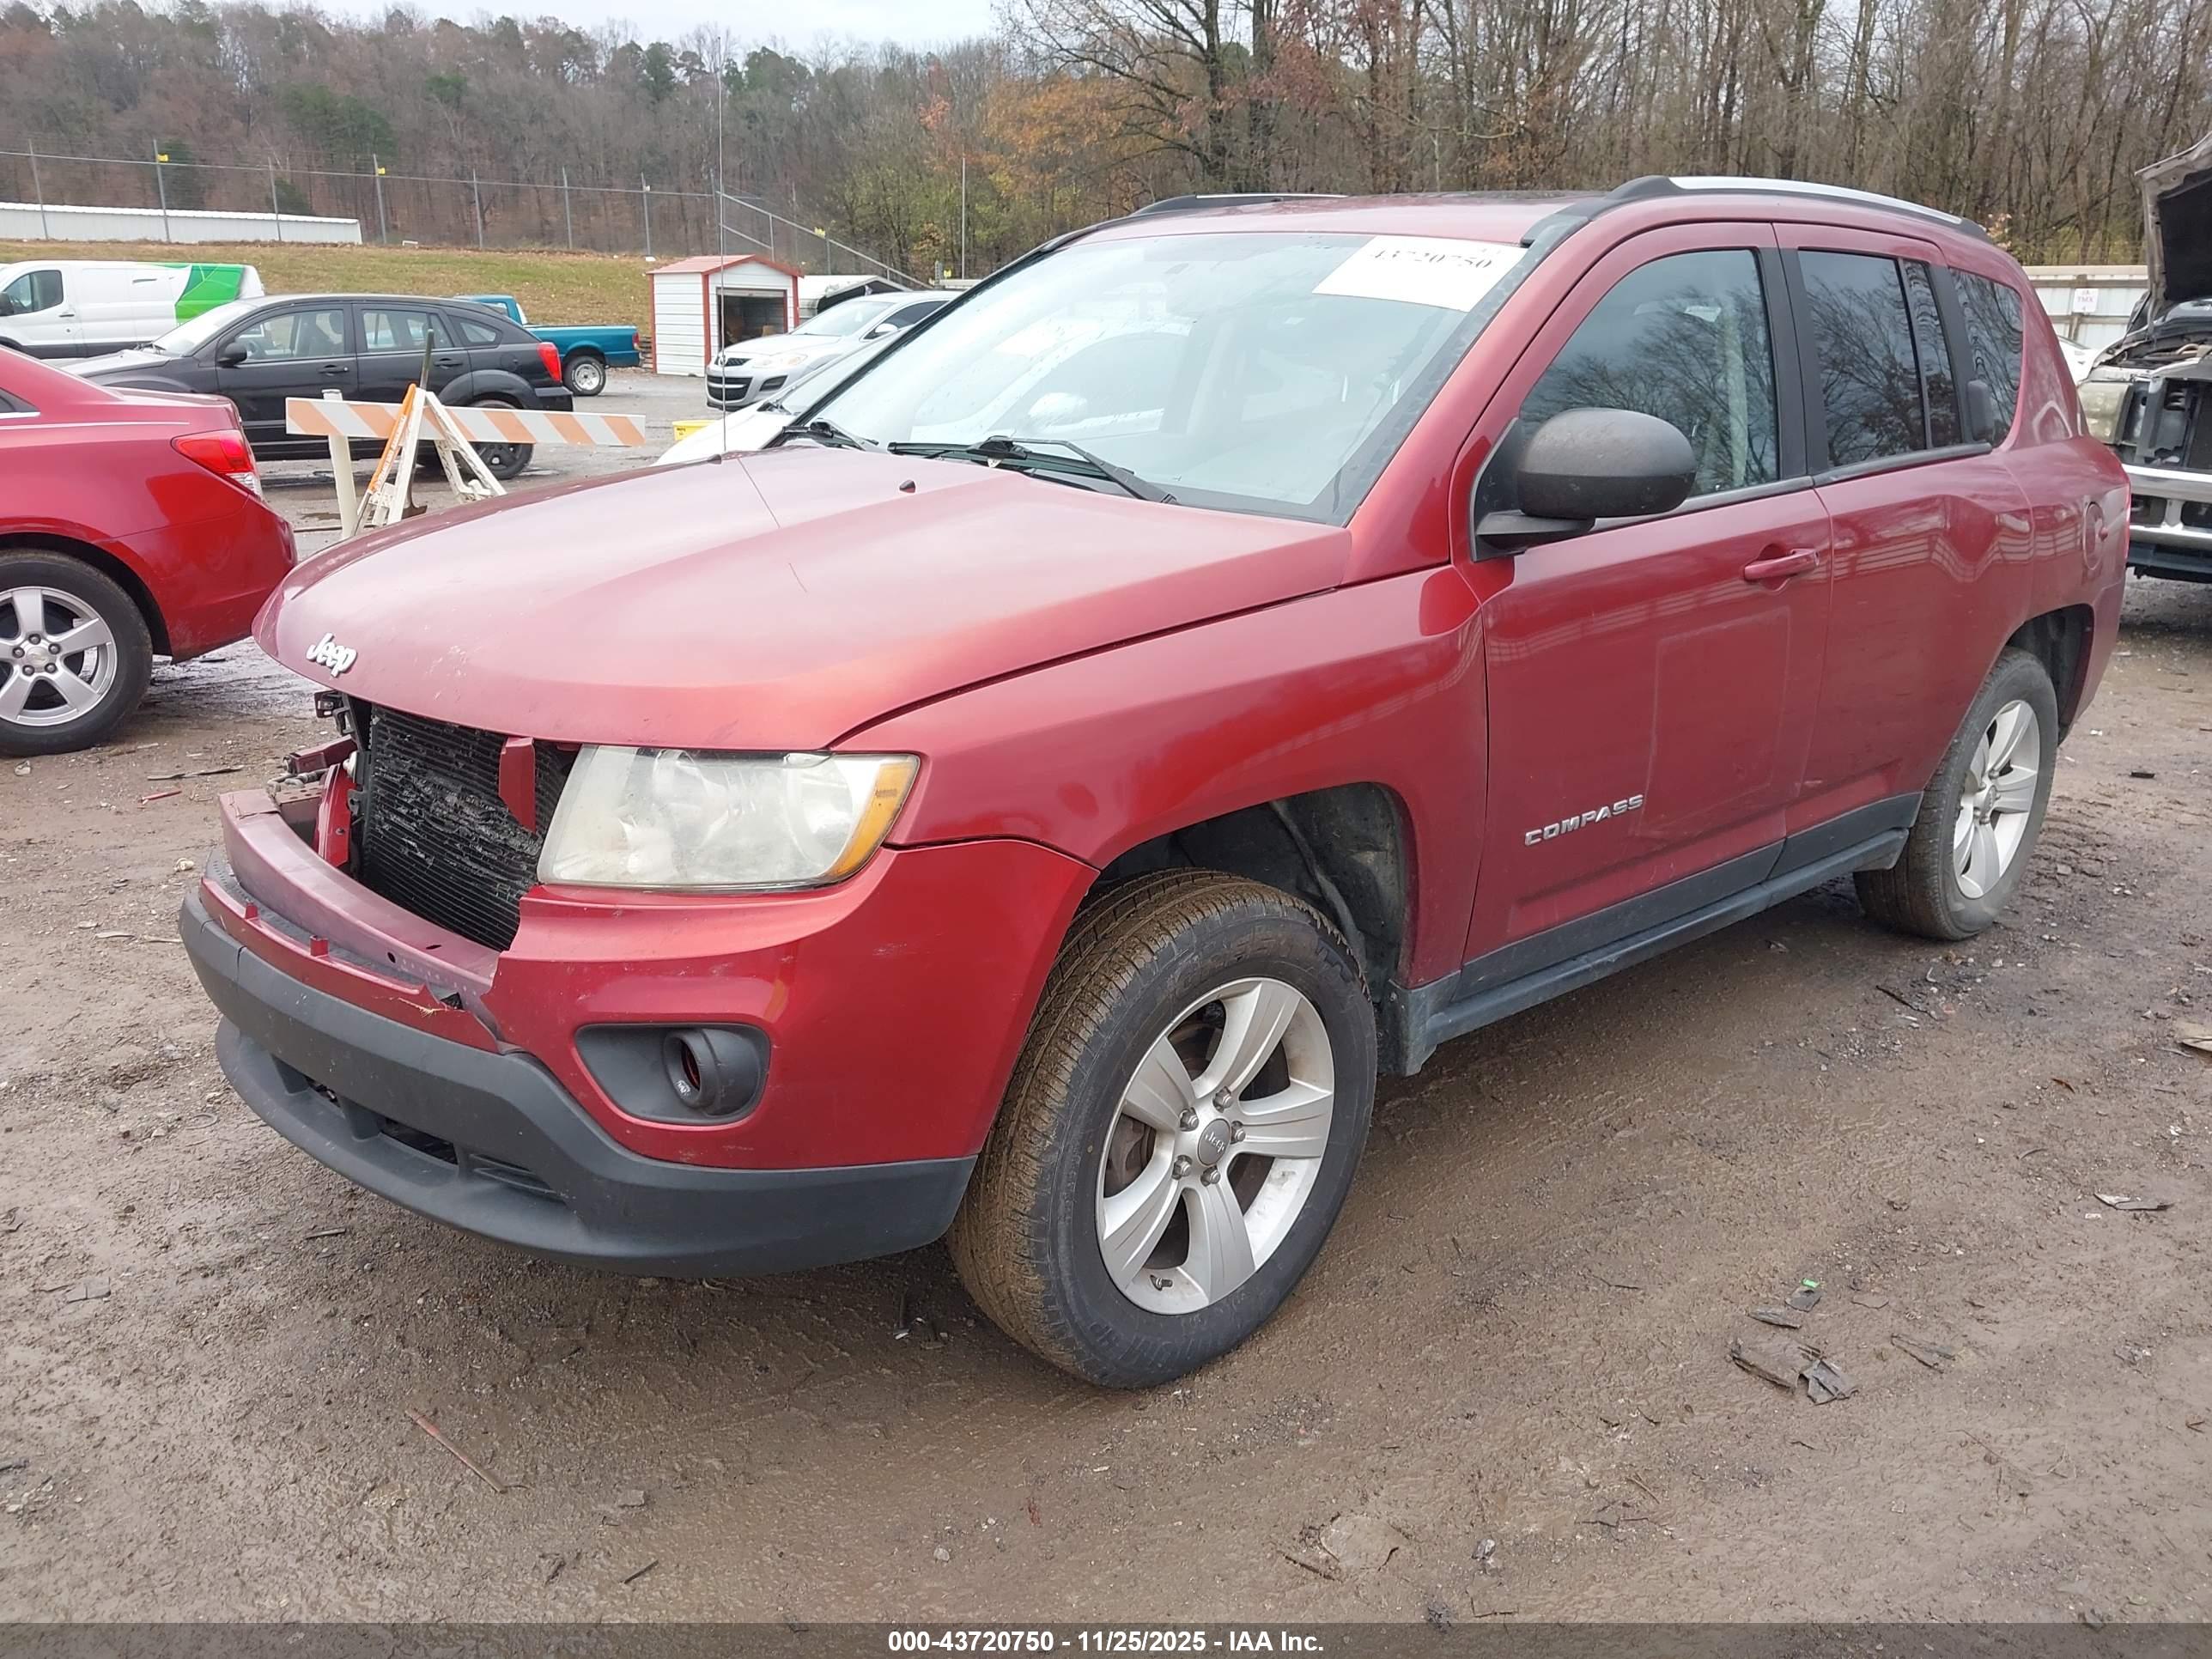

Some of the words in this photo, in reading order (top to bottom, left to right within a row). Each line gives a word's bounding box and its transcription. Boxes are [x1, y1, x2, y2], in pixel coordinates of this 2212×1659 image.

[306, 632, 357, 678] Jeep
[1525, 794, 1644, 846] COMPASS
[1204, 1131, 1225, 1153] Jeep
